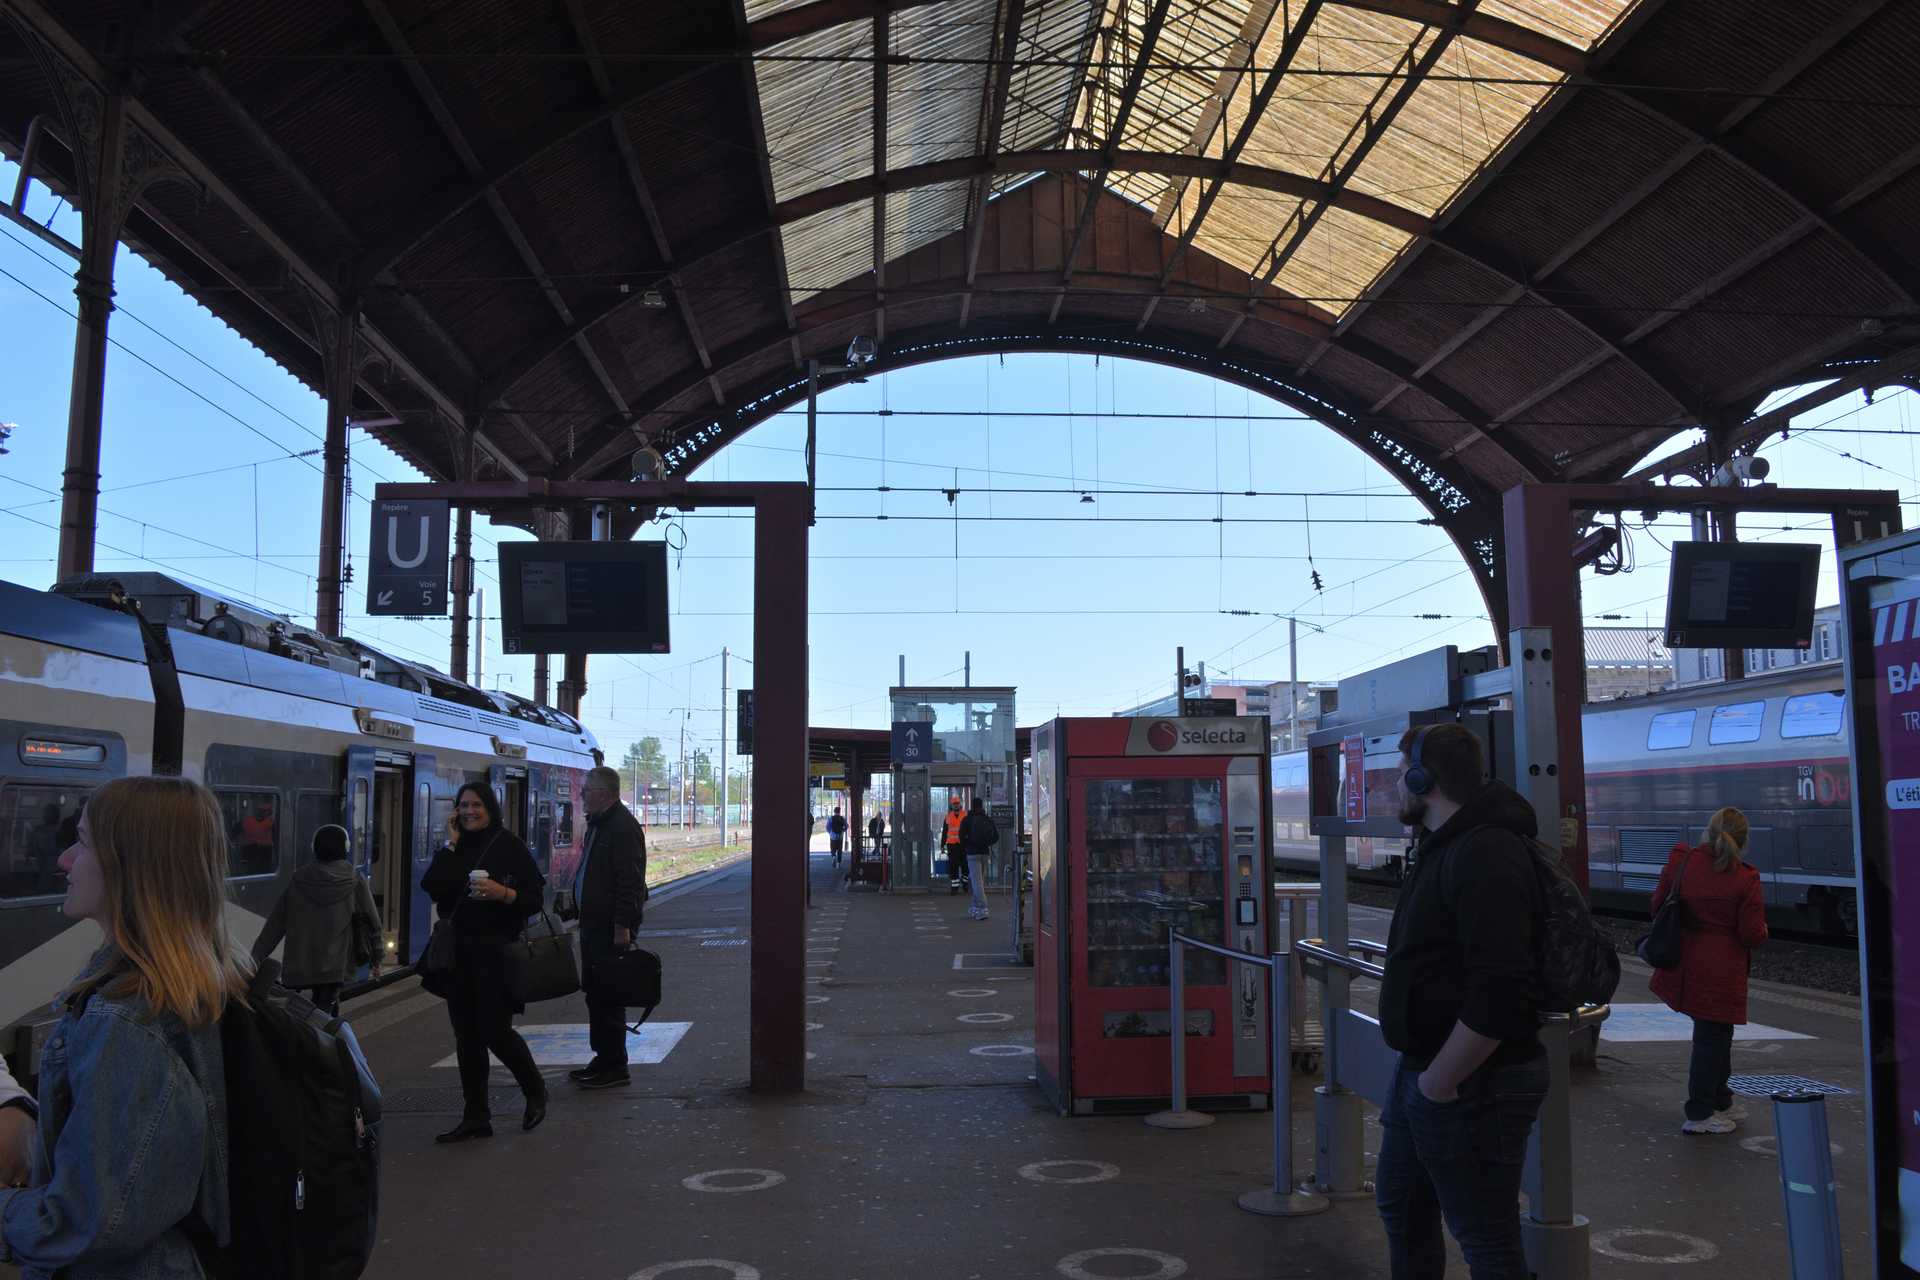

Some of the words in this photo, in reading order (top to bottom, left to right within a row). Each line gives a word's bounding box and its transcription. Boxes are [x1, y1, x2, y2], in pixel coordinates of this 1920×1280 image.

[388, 516, 430, 568] U
[422, 591, 433, 606] 5
[508, 640, 518, 652] 5
[1182, 728, 1246, 744] selecta
[905, 747, 919, 757] 30
[1797, 765, 1814, 776] TGV
